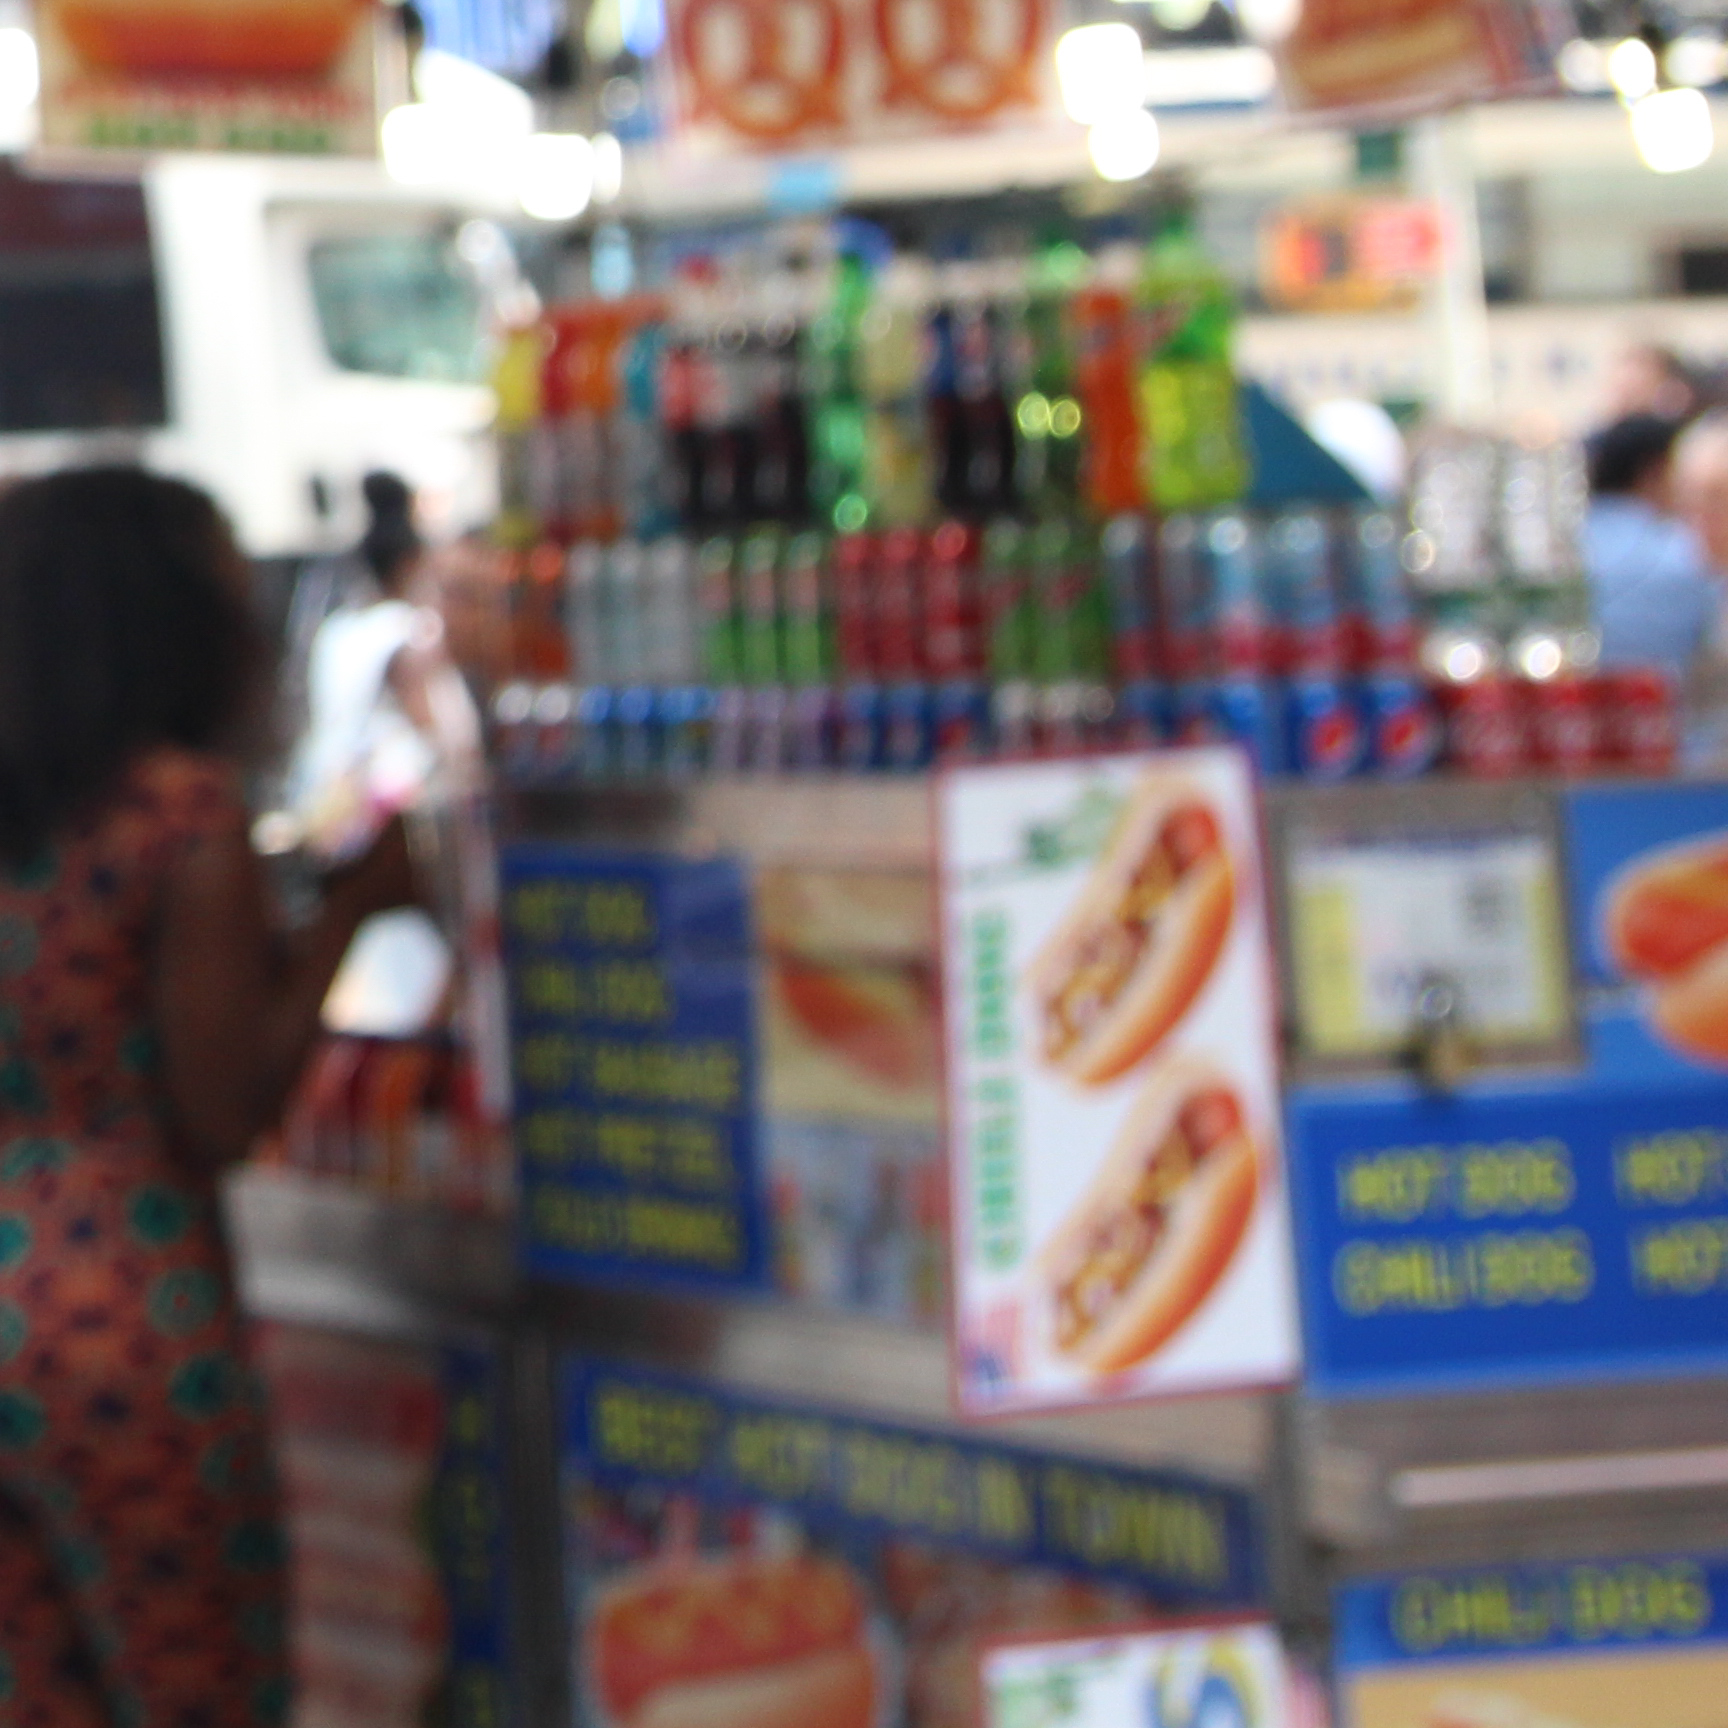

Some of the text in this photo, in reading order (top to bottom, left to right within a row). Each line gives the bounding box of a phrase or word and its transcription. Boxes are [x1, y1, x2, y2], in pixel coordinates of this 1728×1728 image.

[1339, 1136, 1576, 1222] HOT DOG
[1331, 1225, 1596, 1316] CHILI DOG
[1041, 1464, 1232, 1590] TOWN
[1390, 1559, 1711, 1654] CHILI DOG
